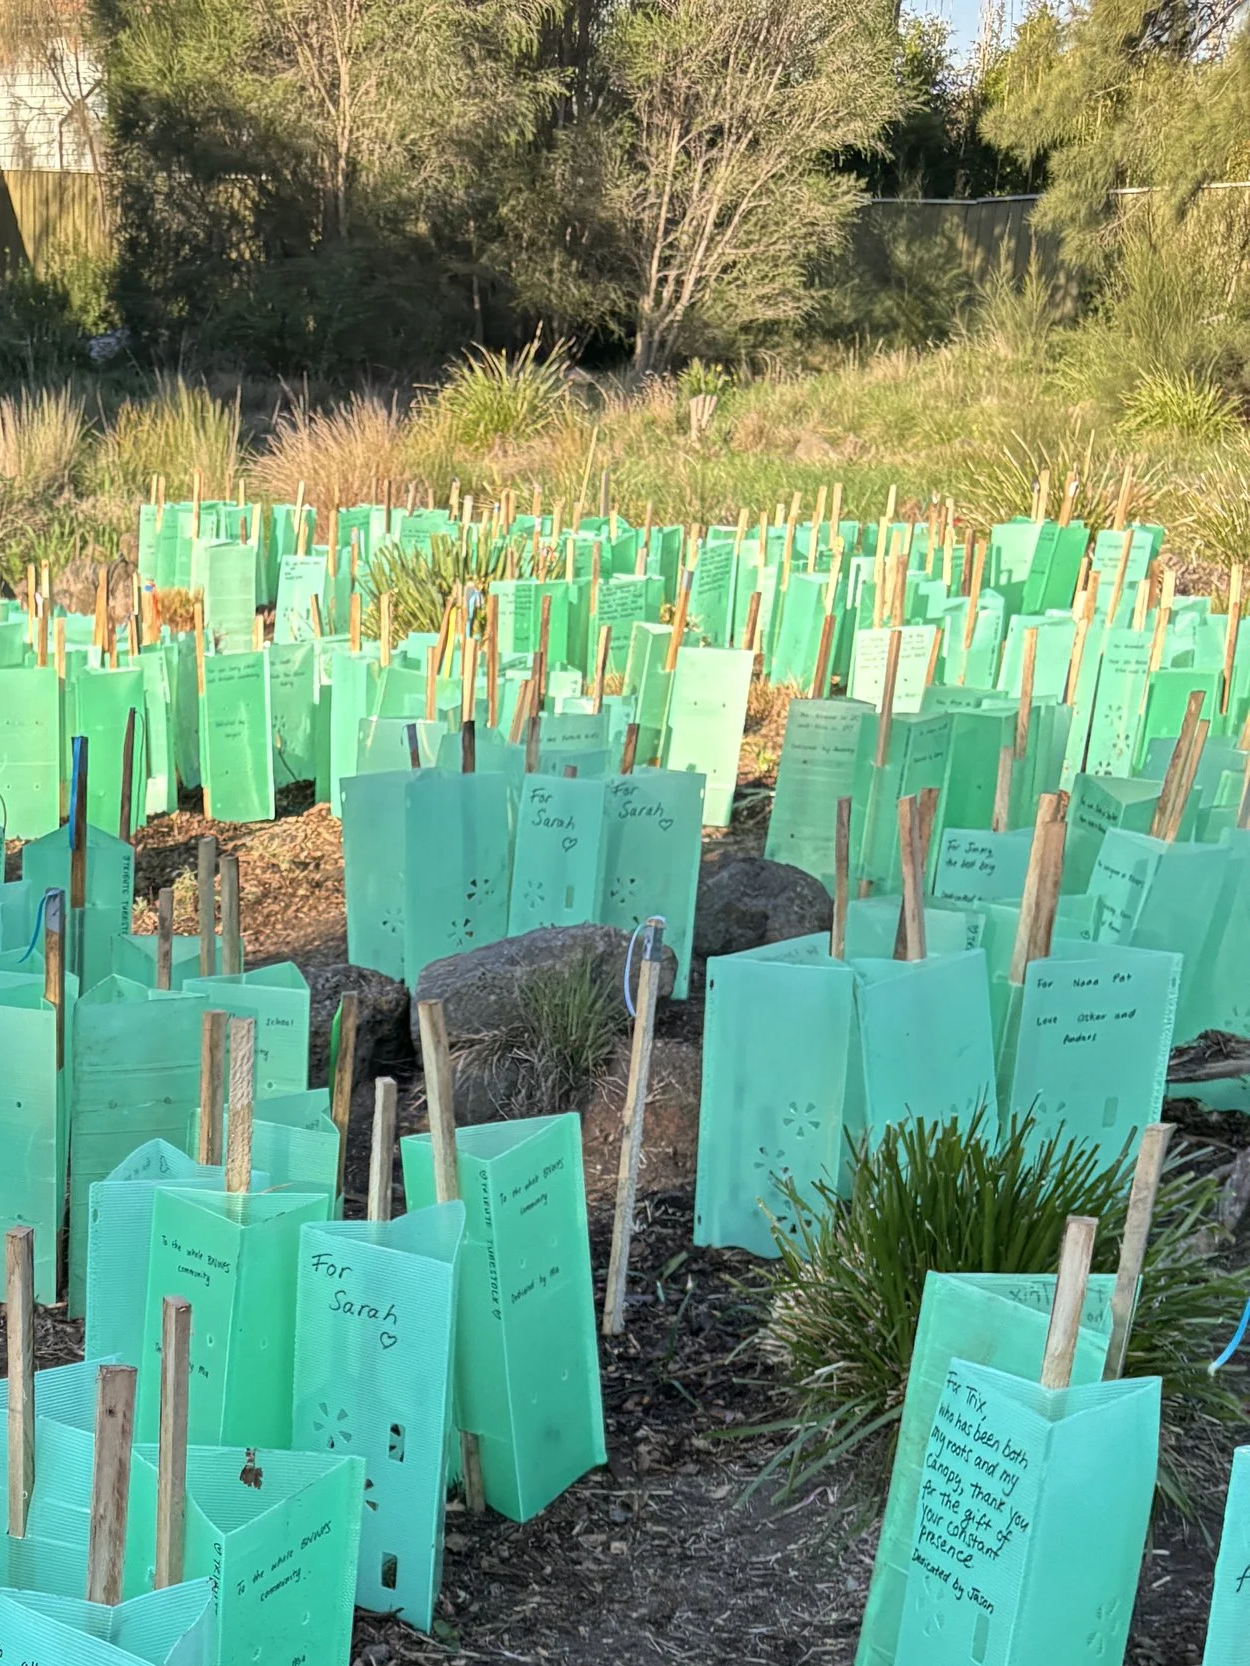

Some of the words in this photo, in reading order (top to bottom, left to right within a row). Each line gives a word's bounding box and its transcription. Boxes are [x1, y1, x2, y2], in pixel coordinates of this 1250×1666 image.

[530, 787, 553, 804] For
[611, 781, 640, 796] For
[532, 808, 575, 830] Sarah
[618, 800, 664, 819] Sarah
[1037, 978, 1054, 989] For
[1112, 973, 1132, 984] Pat
[1036, 1016, 1058, 1027] Love
[1114, 1008, 1137, 1020] and
[161, 1235, 168, 1247] To
[172, 1239, 181, 1252] the
[311, 1253, 353, 1279] For
[329, 1290, 398, 1325] Sarah
[947, 1371, 961, 1393] For
[938, 1403, 954, 1423] who
[954, 1415, 972, 1437] has
[973, 1422, 1000, 1451] been
[1002, 1438, 1029, 1470] both
[931, 1425, 946, 1457] my
[946, 1439, 972, 1462] roots
[974, 1455, 997, 1478] and
[999, 1470, 1019, 1497] my
[923, 1480, 935, 1500] for
[964, 1508, 992, 1532] gift
[996, 1529, 1013, 1550] of
[921, 1503, 943, 1527] your
[947, 1519, 1000, 1561] constant
[237, 1580, 246, 1596] To
[252, 1569, 265, 1584] the
[271, 1550, 294, 1571] whole
[260, 1568, 302, 1602] community
[911, 1548, 951, 1583] Dedicated
[953, 1578, 964, 1601] by
[967, 1587, 995, 1614] Jason
